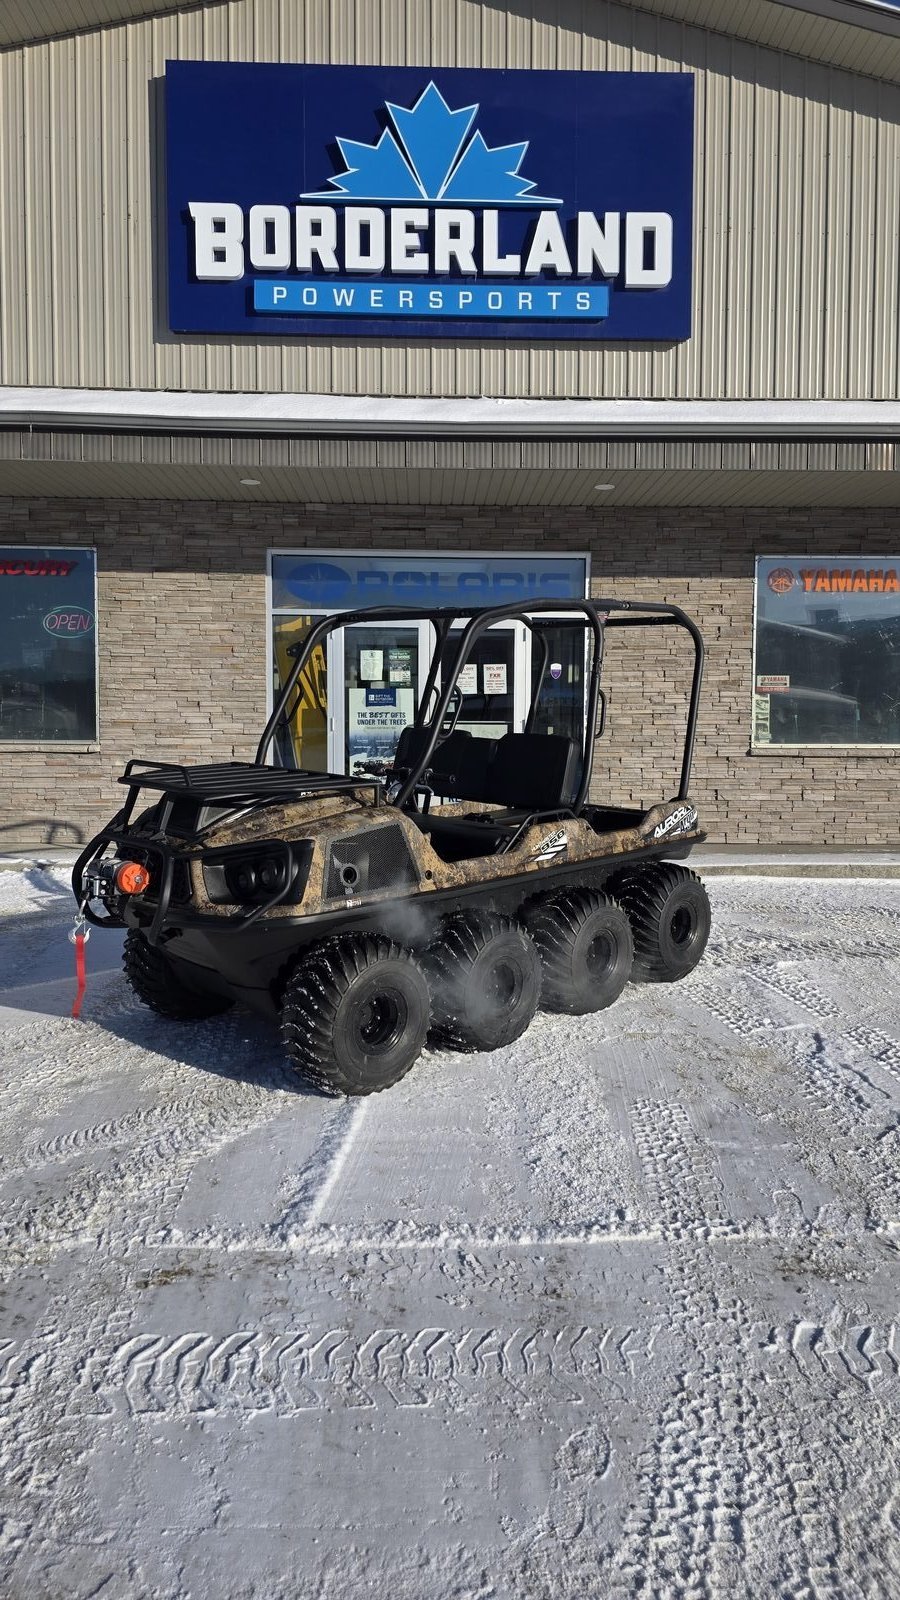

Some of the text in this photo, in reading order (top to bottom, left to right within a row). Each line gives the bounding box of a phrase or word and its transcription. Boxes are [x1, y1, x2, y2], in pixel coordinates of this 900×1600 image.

[188, 202, 673, 289] BORDERLAND
[273, 286, 591, 311] POWERSPORTS
[357, 570, 570, 598] POLARIS
[799, 567, 900, 593] YAMAHA
[46, 614, 91, 630] OPEN
[369, 711, 390, 719] BEST
[653, 805, 693, 838] AURORA
[541, 829, 565, 853] 950
